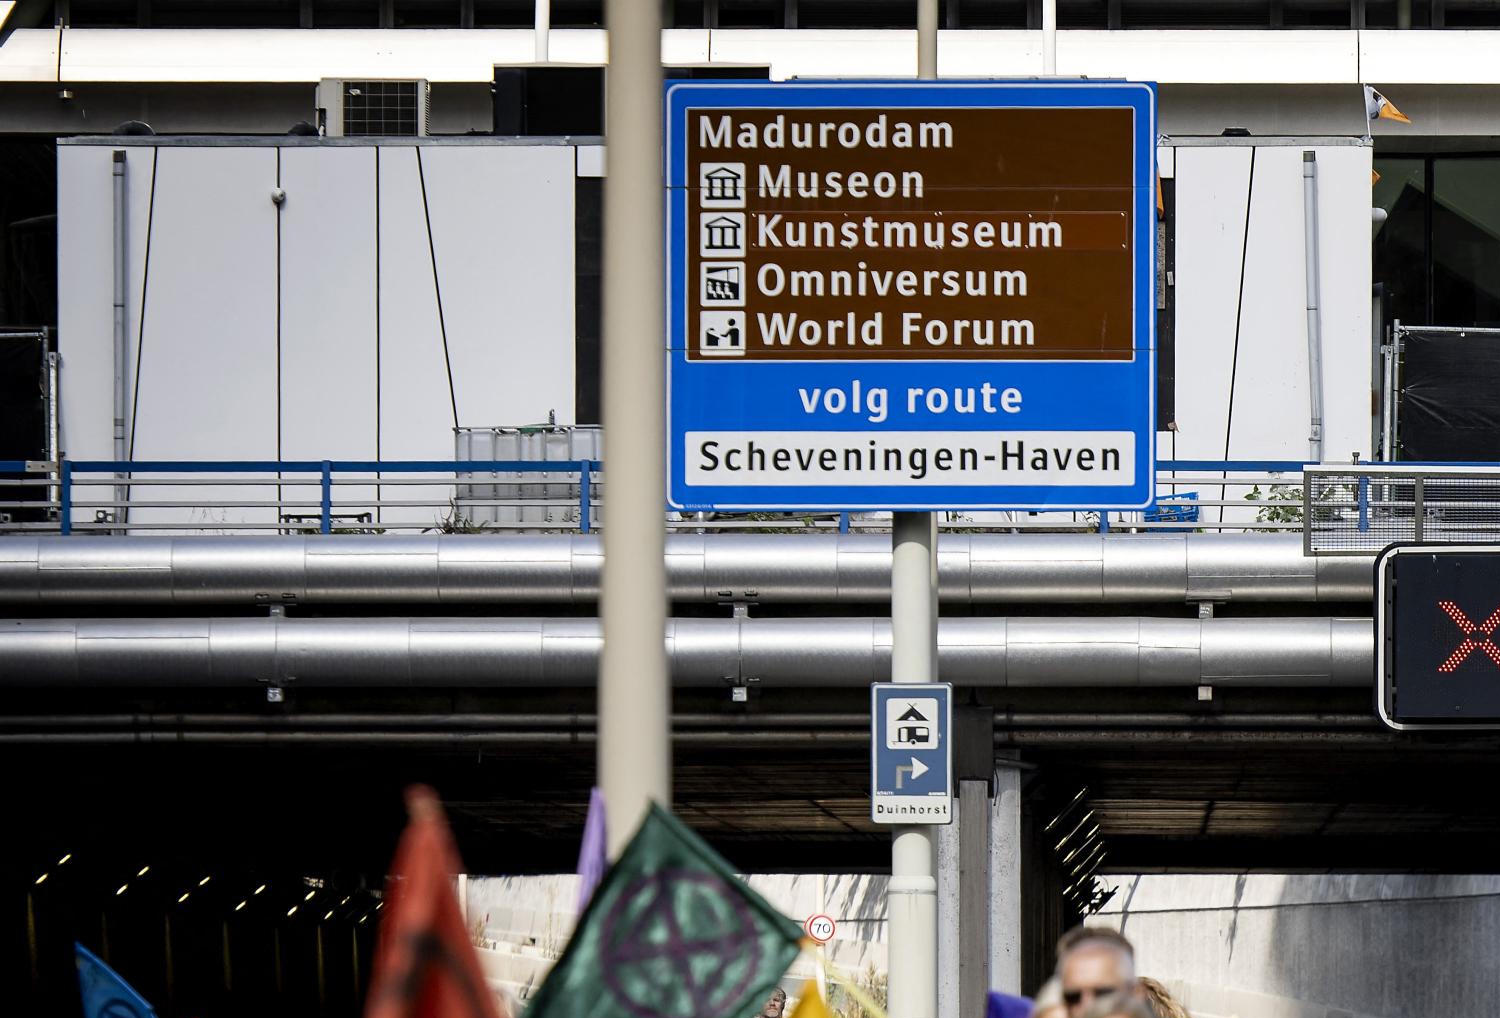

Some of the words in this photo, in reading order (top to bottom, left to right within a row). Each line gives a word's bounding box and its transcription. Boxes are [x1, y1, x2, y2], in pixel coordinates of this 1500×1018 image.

[699, 114, 954, 149] Madurodam
[758, 164, 925, 199] Museon
[758, 214, 1063, 248] Kunstmuseum
[757, 262, 1028, 297] Omniversum
[757, 312, 884, 346] World
[902, 312, 1035, 346] Forum
[798, 379, 889, 423] volg
[906, 382, 1024, 414] route
[700, 440, 1121, 480] Scheveningen-Haven
[877, 804, 947, 814] Duinhorst
[813, 923, 831, 934] 70
